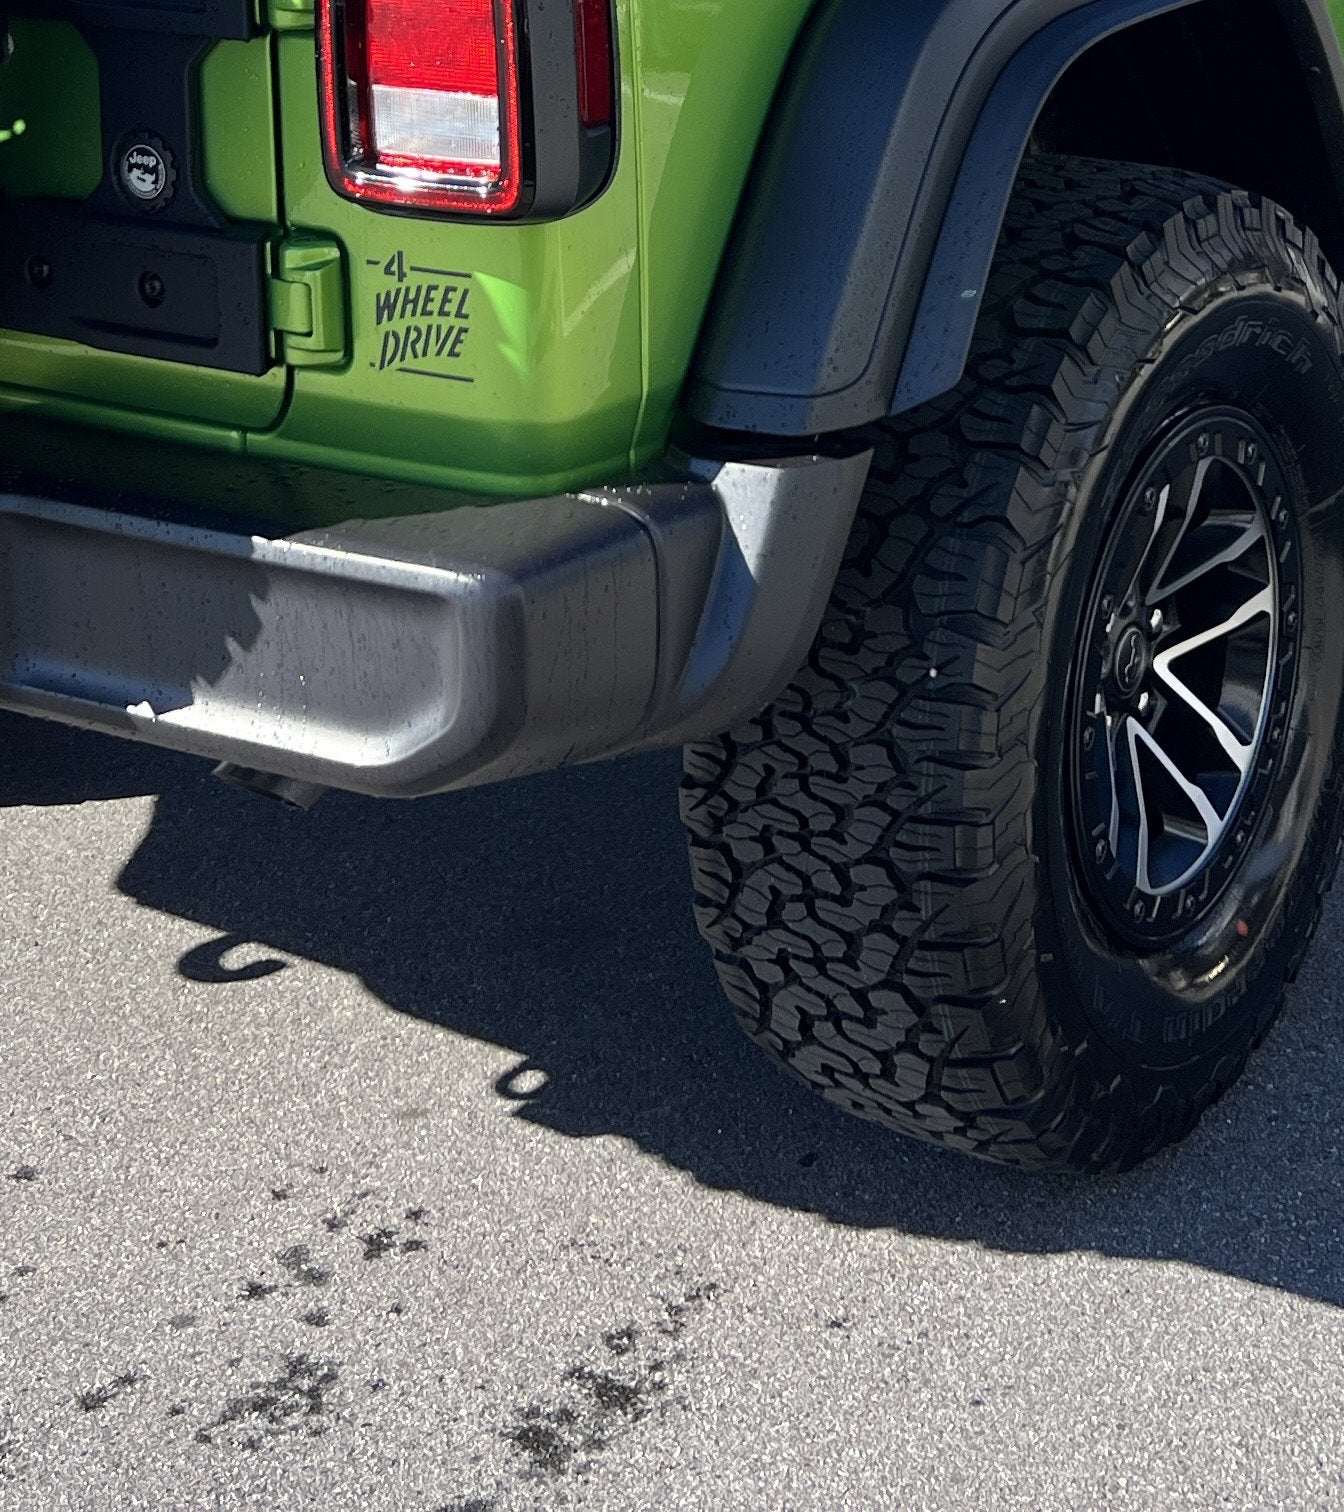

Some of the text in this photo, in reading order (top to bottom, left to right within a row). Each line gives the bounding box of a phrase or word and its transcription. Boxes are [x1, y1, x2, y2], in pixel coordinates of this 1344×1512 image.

[129, 151, 157, 168] Jeep
[383, 250, 408, 283] 4
[375, 284, 470, 326] WHEEL
[378, 323, 470, 371] DRIVE
